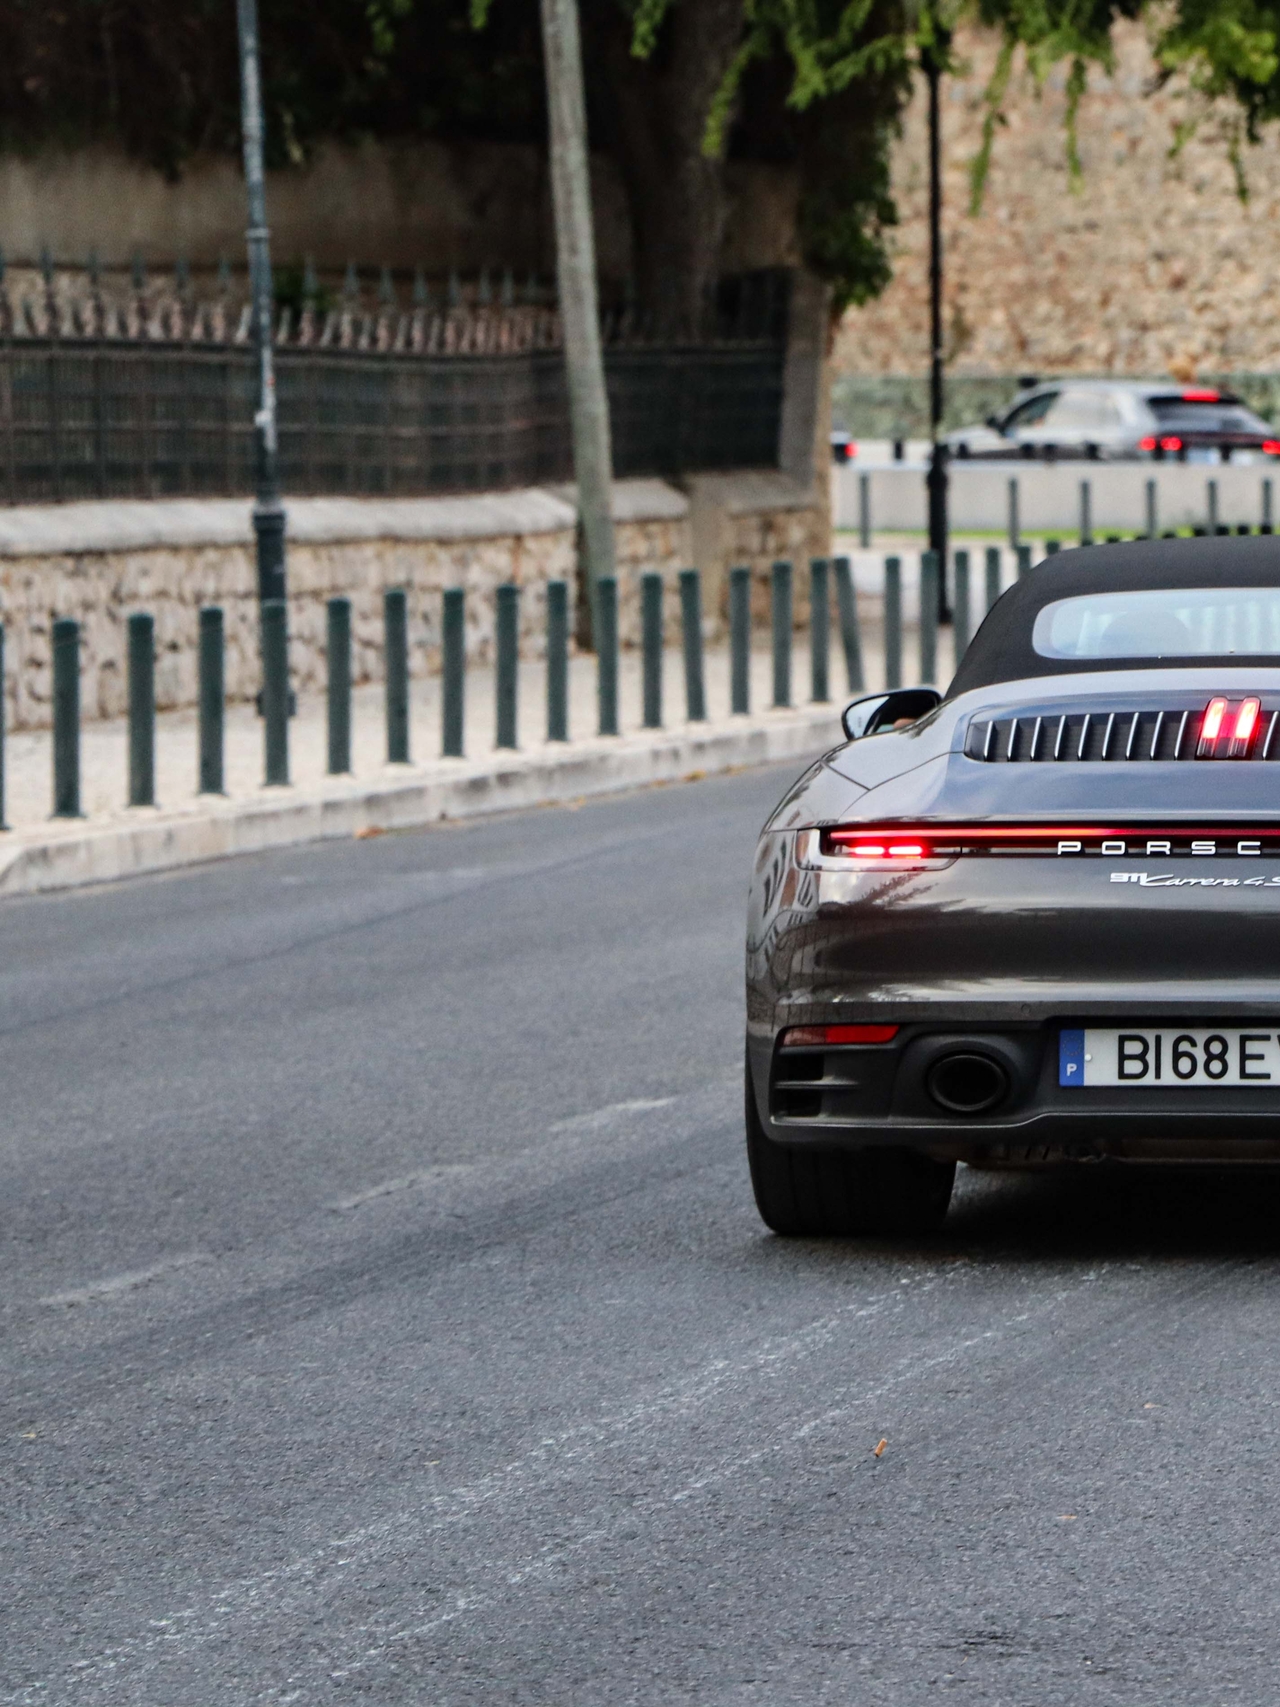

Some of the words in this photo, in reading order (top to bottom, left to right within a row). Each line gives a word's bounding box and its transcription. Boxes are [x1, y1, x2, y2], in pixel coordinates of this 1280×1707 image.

[1110, 872, 1148, 884] 911
[1140, 874, 1240, 887] Carrera
[1066, 1063, 1077, 1077] P
